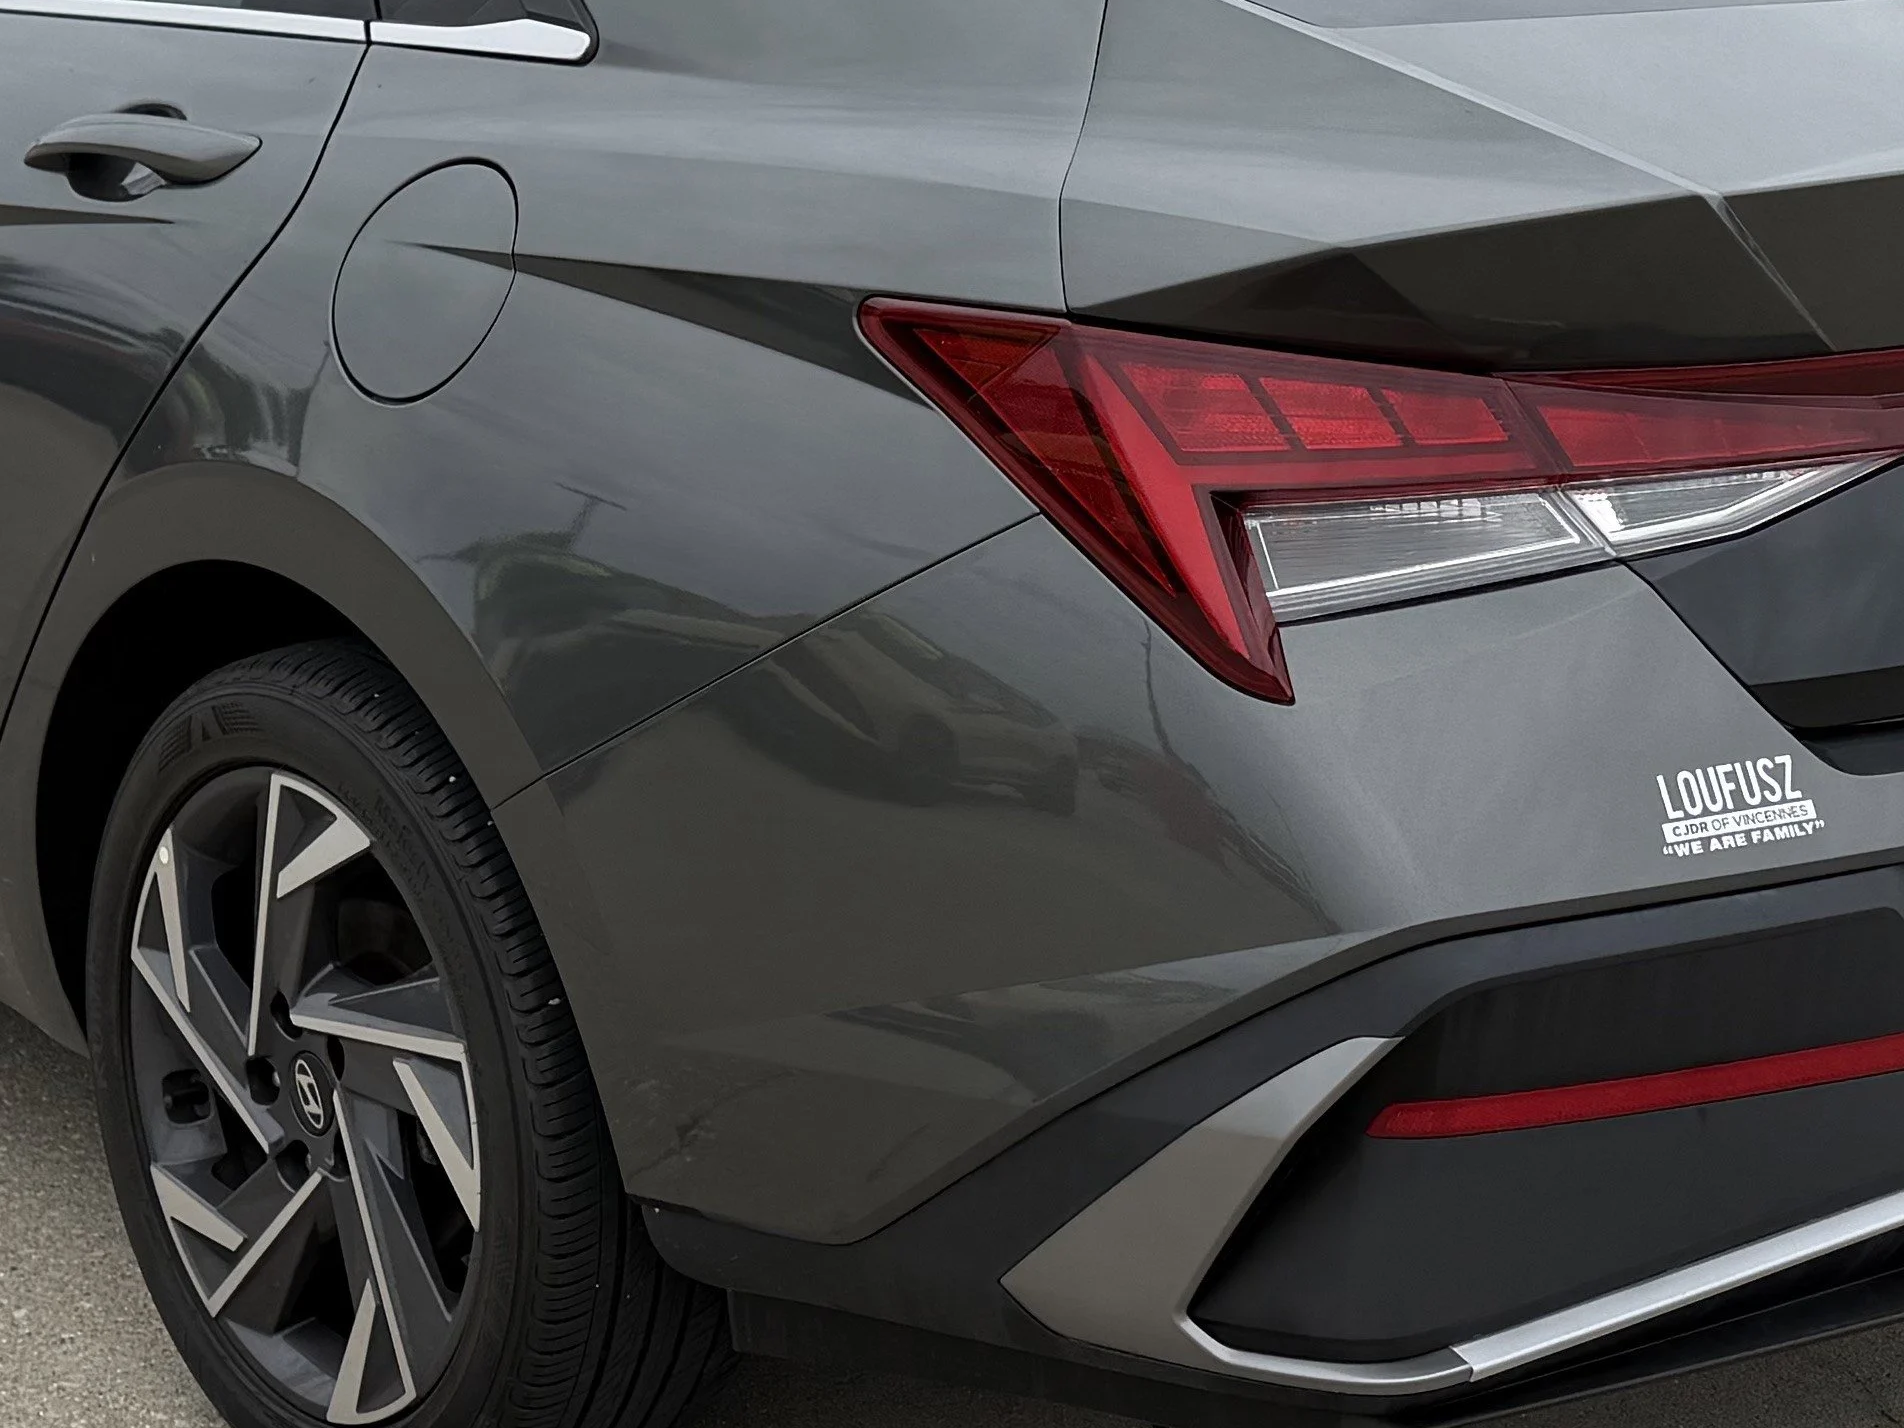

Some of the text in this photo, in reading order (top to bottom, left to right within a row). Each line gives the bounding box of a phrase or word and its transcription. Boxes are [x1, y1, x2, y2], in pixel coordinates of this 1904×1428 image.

[1672, 804, 1809, 838] CJDR OF VINCENNES
[1709, 833, 1748, 852] ARE
